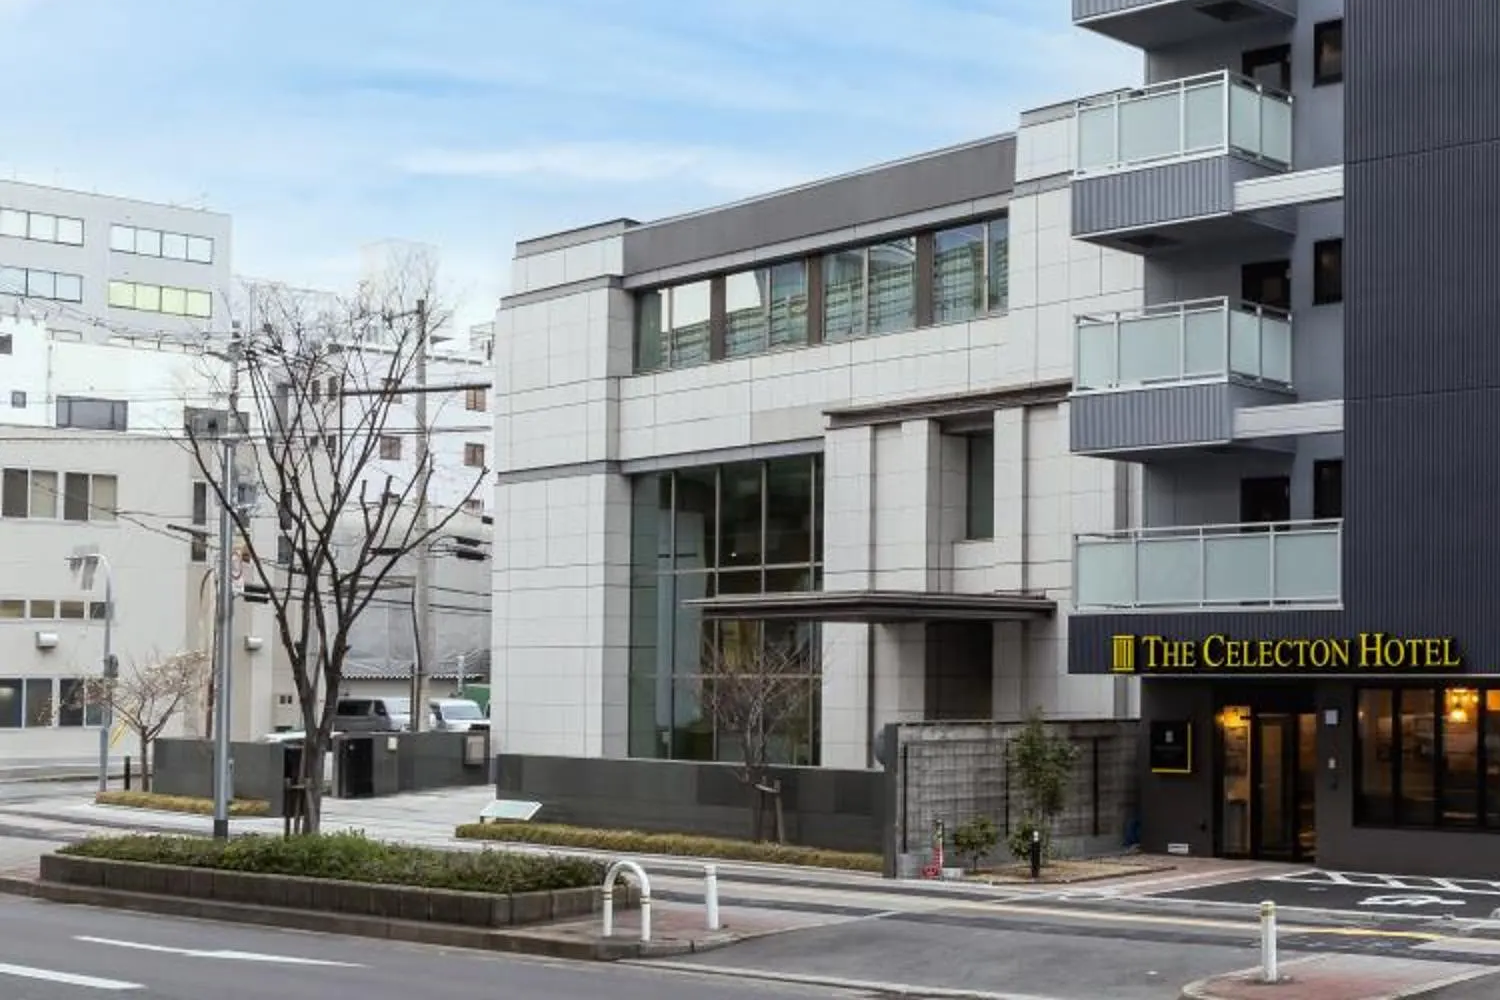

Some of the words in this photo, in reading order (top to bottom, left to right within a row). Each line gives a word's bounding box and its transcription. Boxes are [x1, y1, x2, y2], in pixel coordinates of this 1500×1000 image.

[1141, 634, 1197, 667] THE
[1203, 634, 1350, 667] CELECTON
[1358, 633, 1461, 667] HOTEL
